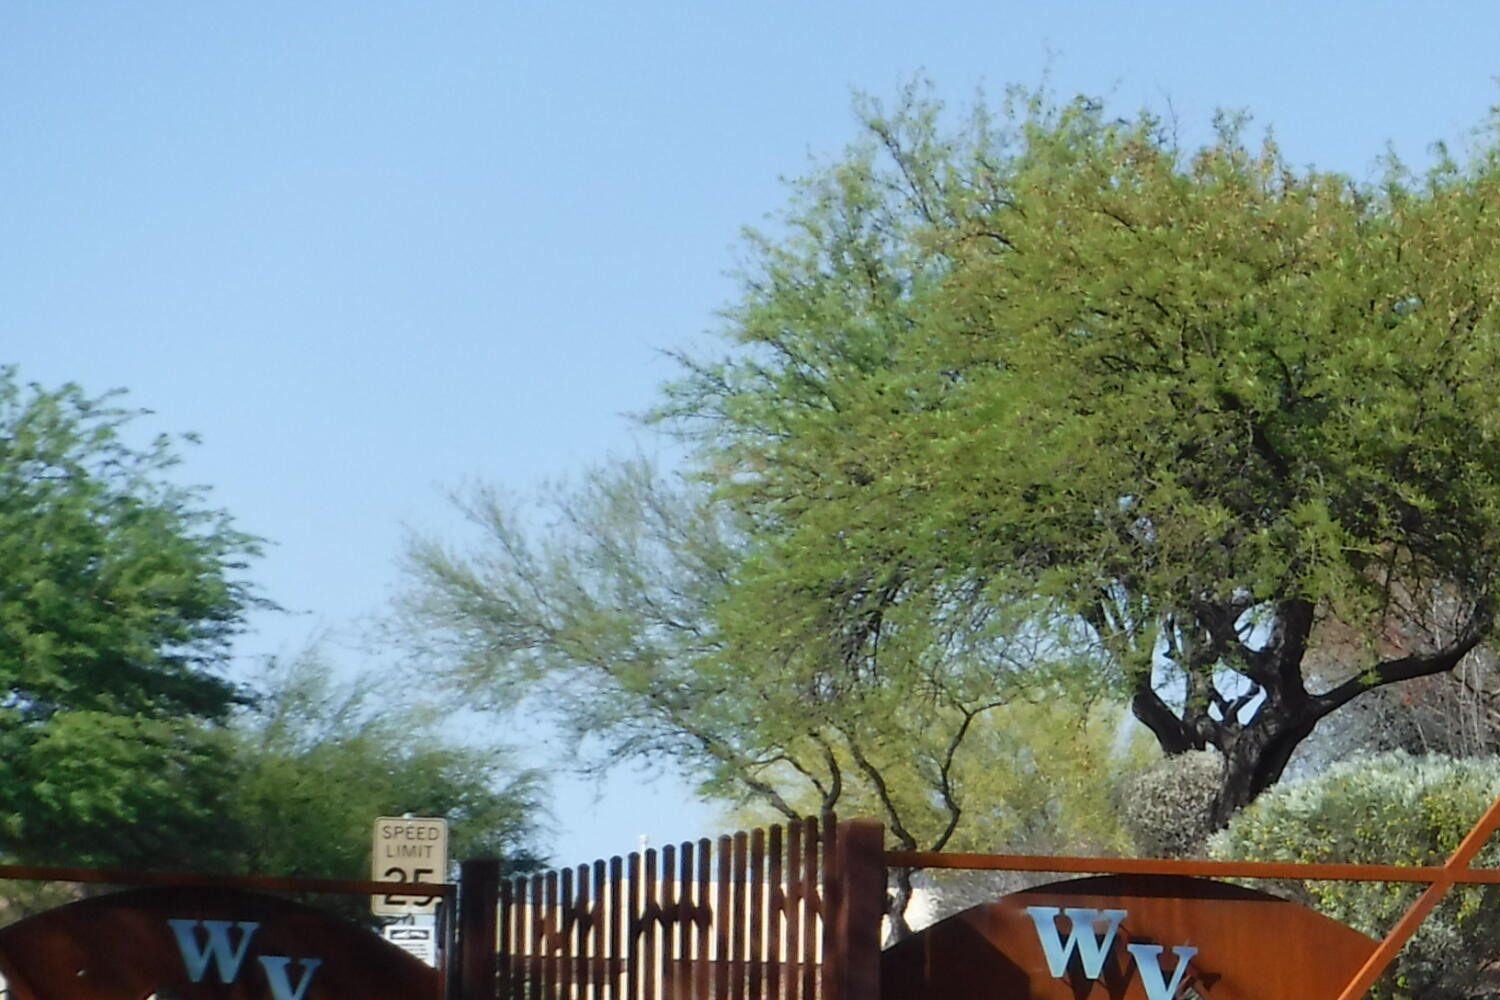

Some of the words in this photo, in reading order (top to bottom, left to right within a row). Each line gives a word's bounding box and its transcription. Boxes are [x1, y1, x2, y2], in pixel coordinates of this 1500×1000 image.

[382, 826, 439, 840] SPEED
[386, 845, 432, 858] LIMIT
[384, 867, 434, 906] 25
